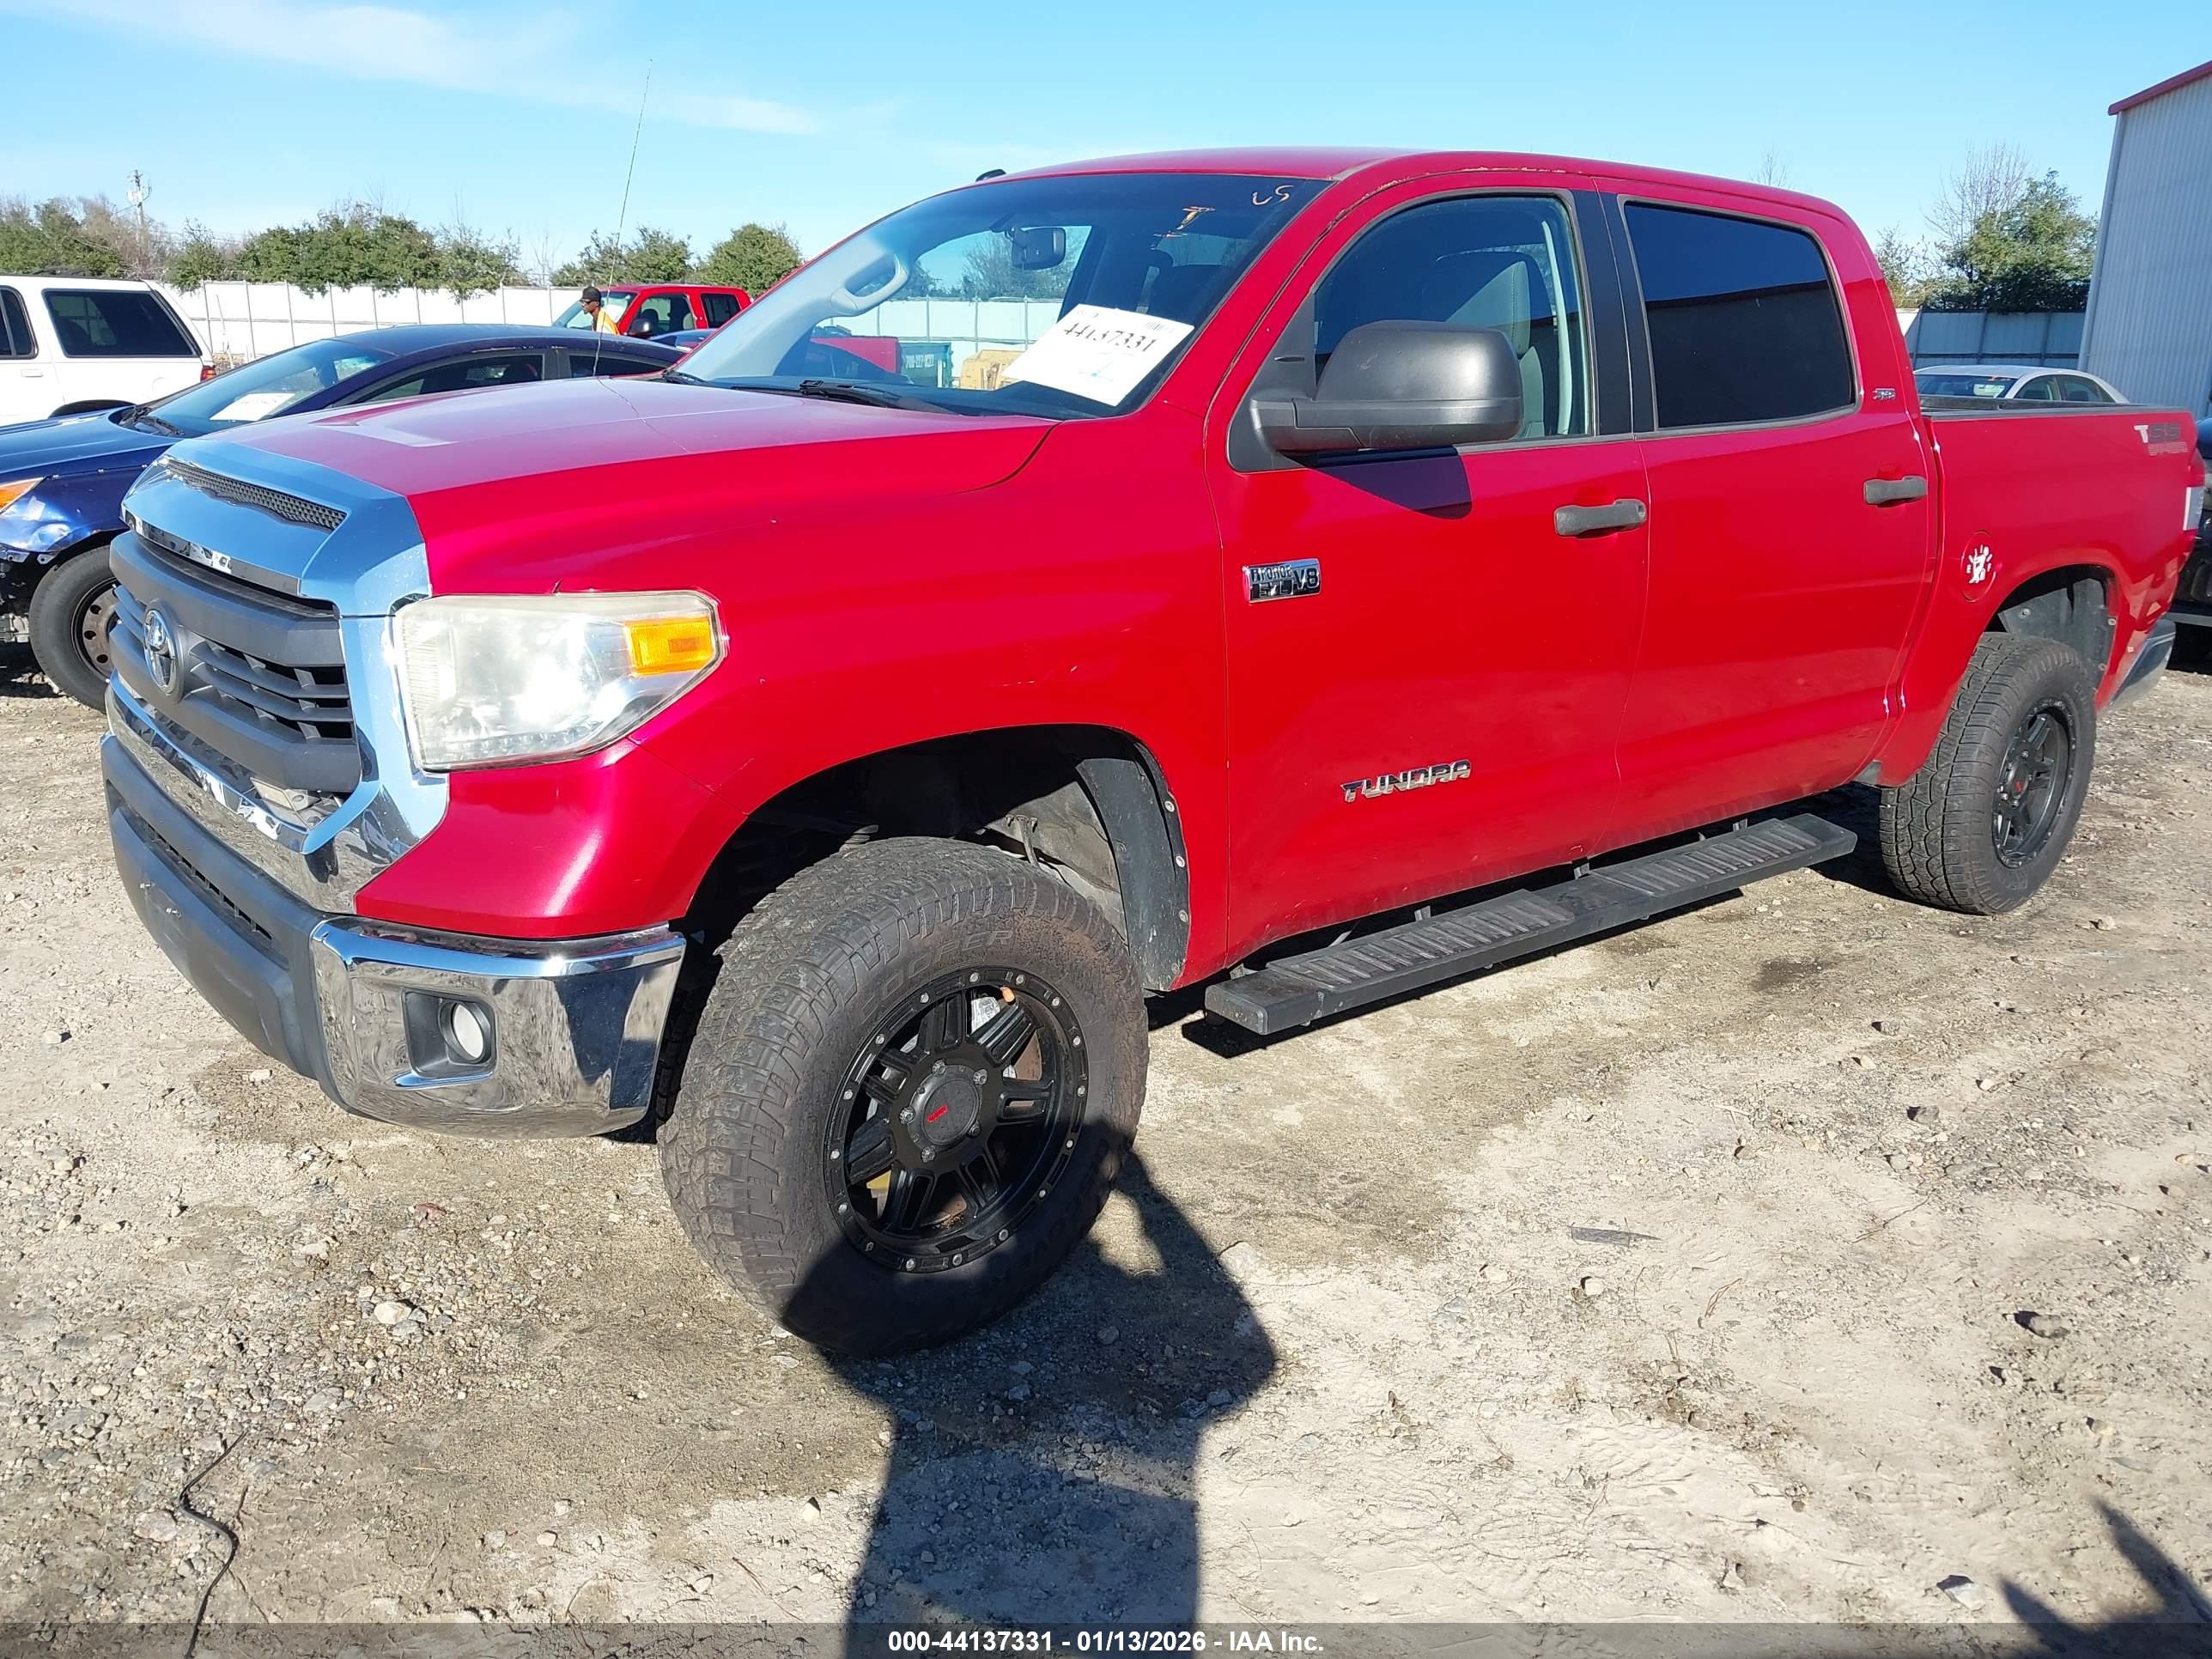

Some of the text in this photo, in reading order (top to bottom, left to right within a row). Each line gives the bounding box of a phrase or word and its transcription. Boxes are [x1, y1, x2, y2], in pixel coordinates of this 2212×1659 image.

[1063, 322, 1157, 352] 44137331
[1294, 567, 1319, 590] V8
[1340, 759, 1471, 803] TUNDRA
